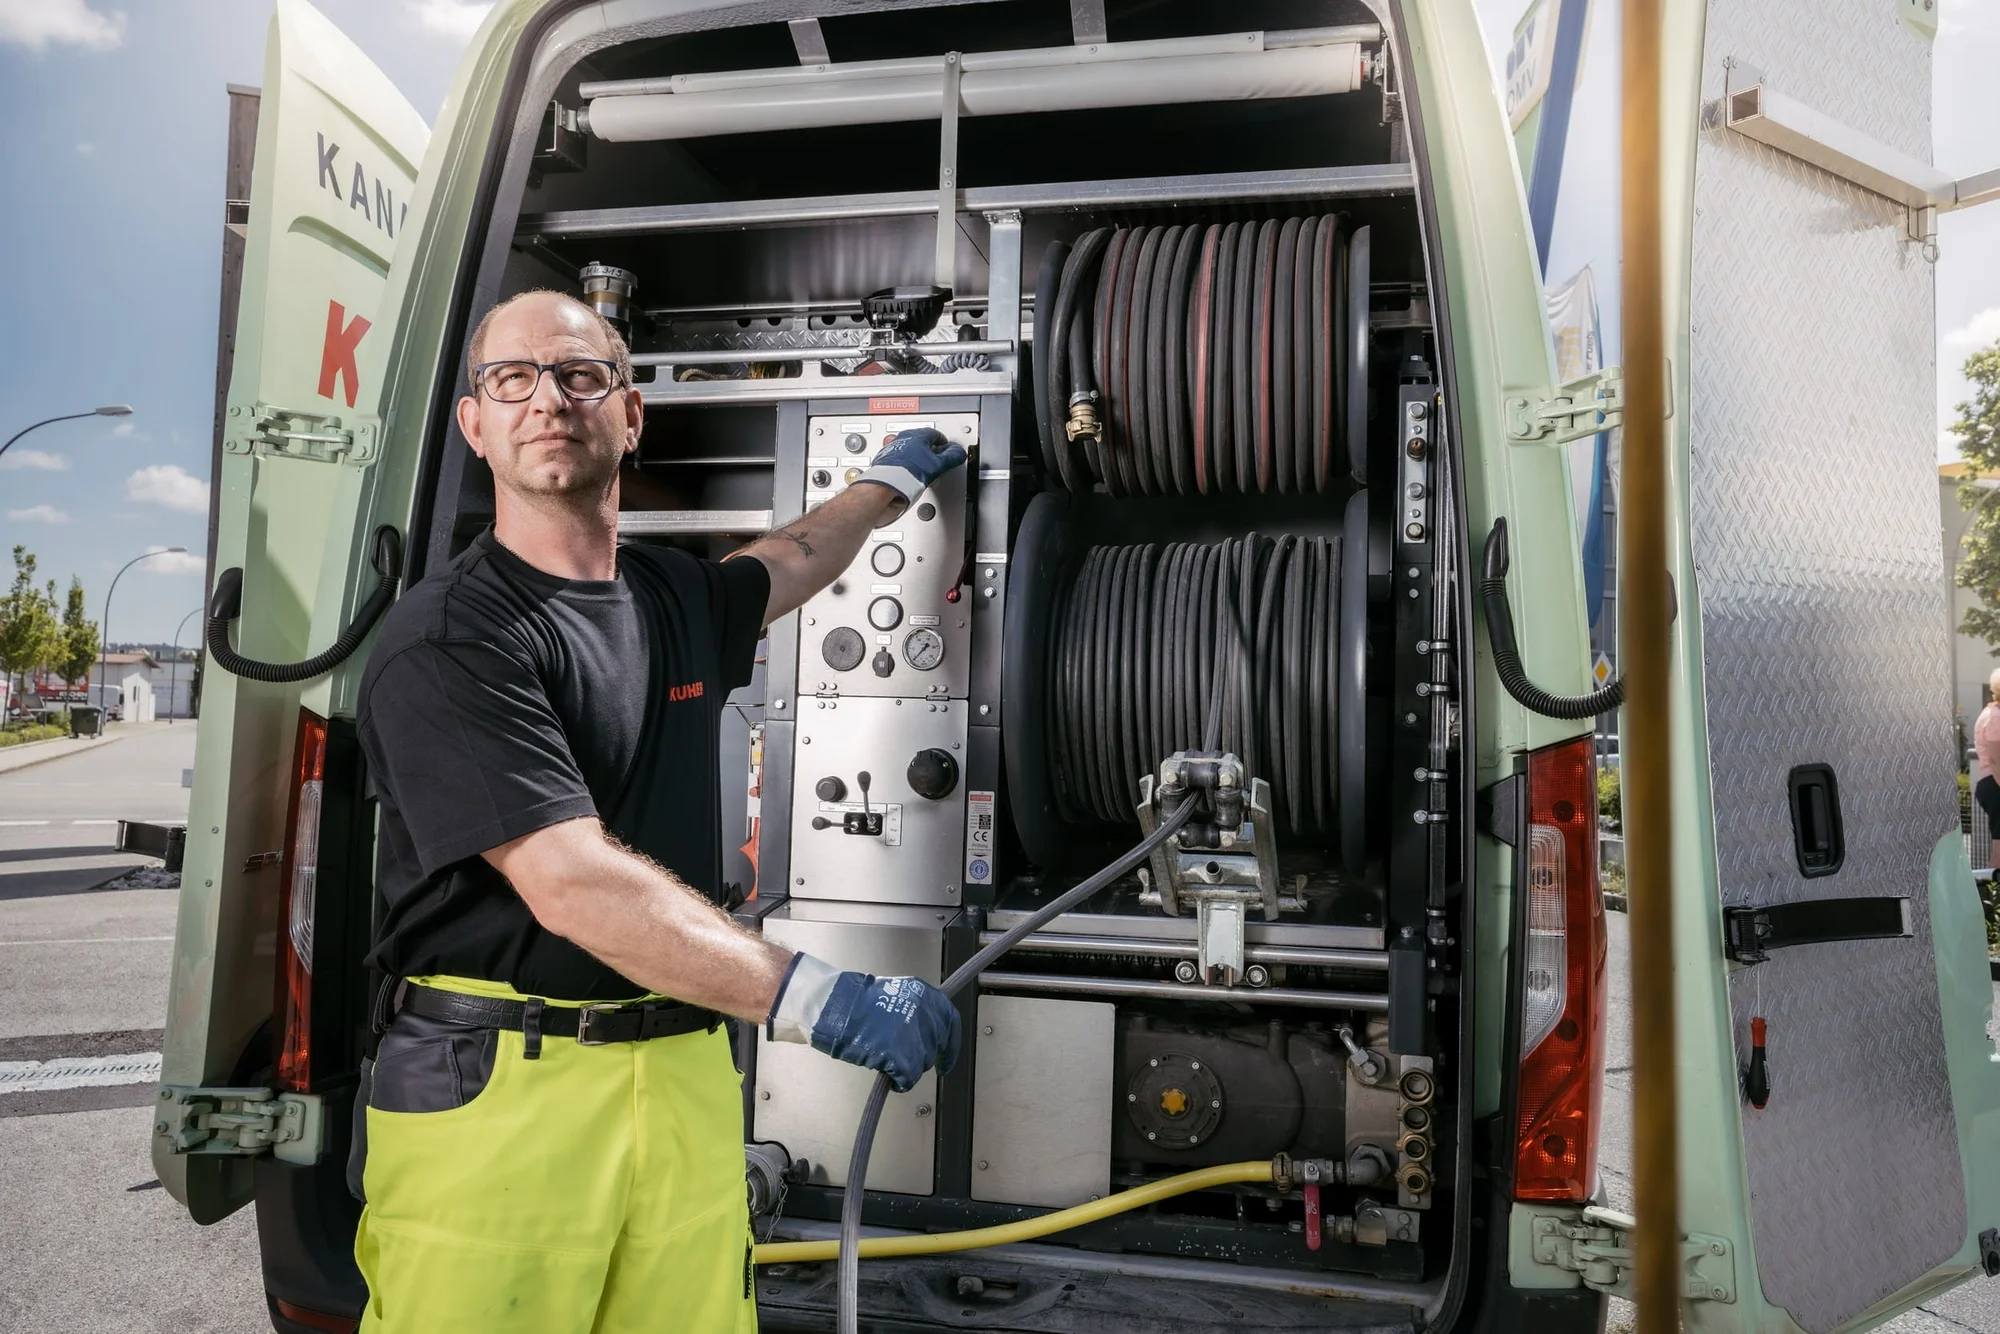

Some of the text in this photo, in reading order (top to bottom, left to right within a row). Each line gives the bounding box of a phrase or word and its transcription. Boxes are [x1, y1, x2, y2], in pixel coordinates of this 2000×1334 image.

[1506, 57, 1537, 117] OMV
[317, 298, 373, 409] K
[973, 830, 988, 842] CE
[876, 995, 889, 1009] CE
